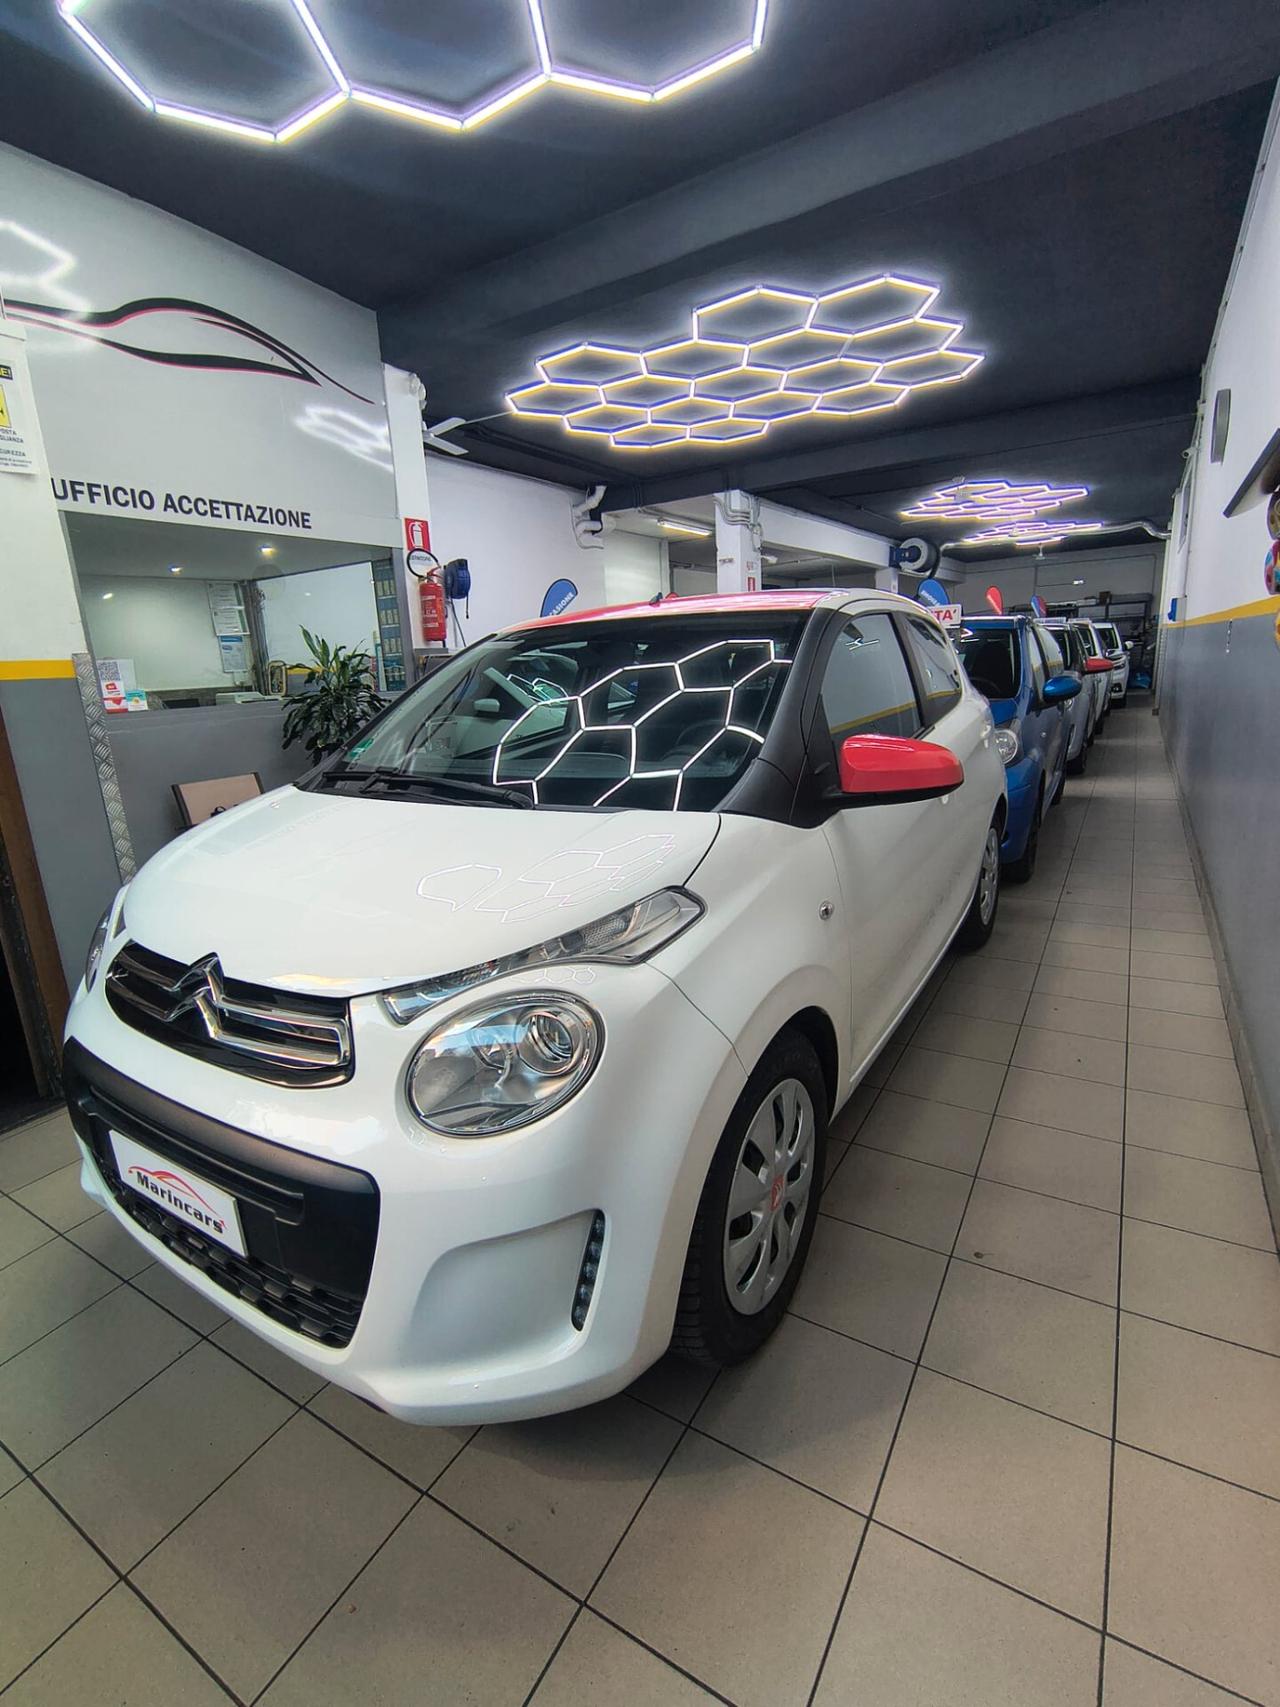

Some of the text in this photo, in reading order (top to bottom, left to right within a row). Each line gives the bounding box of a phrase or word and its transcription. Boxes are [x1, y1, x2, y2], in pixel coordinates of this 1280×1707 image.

[51, 477, 312, 530] UFFICIO ACCETTAZIONE
[136, 1171, 224, 1234] Marincars
